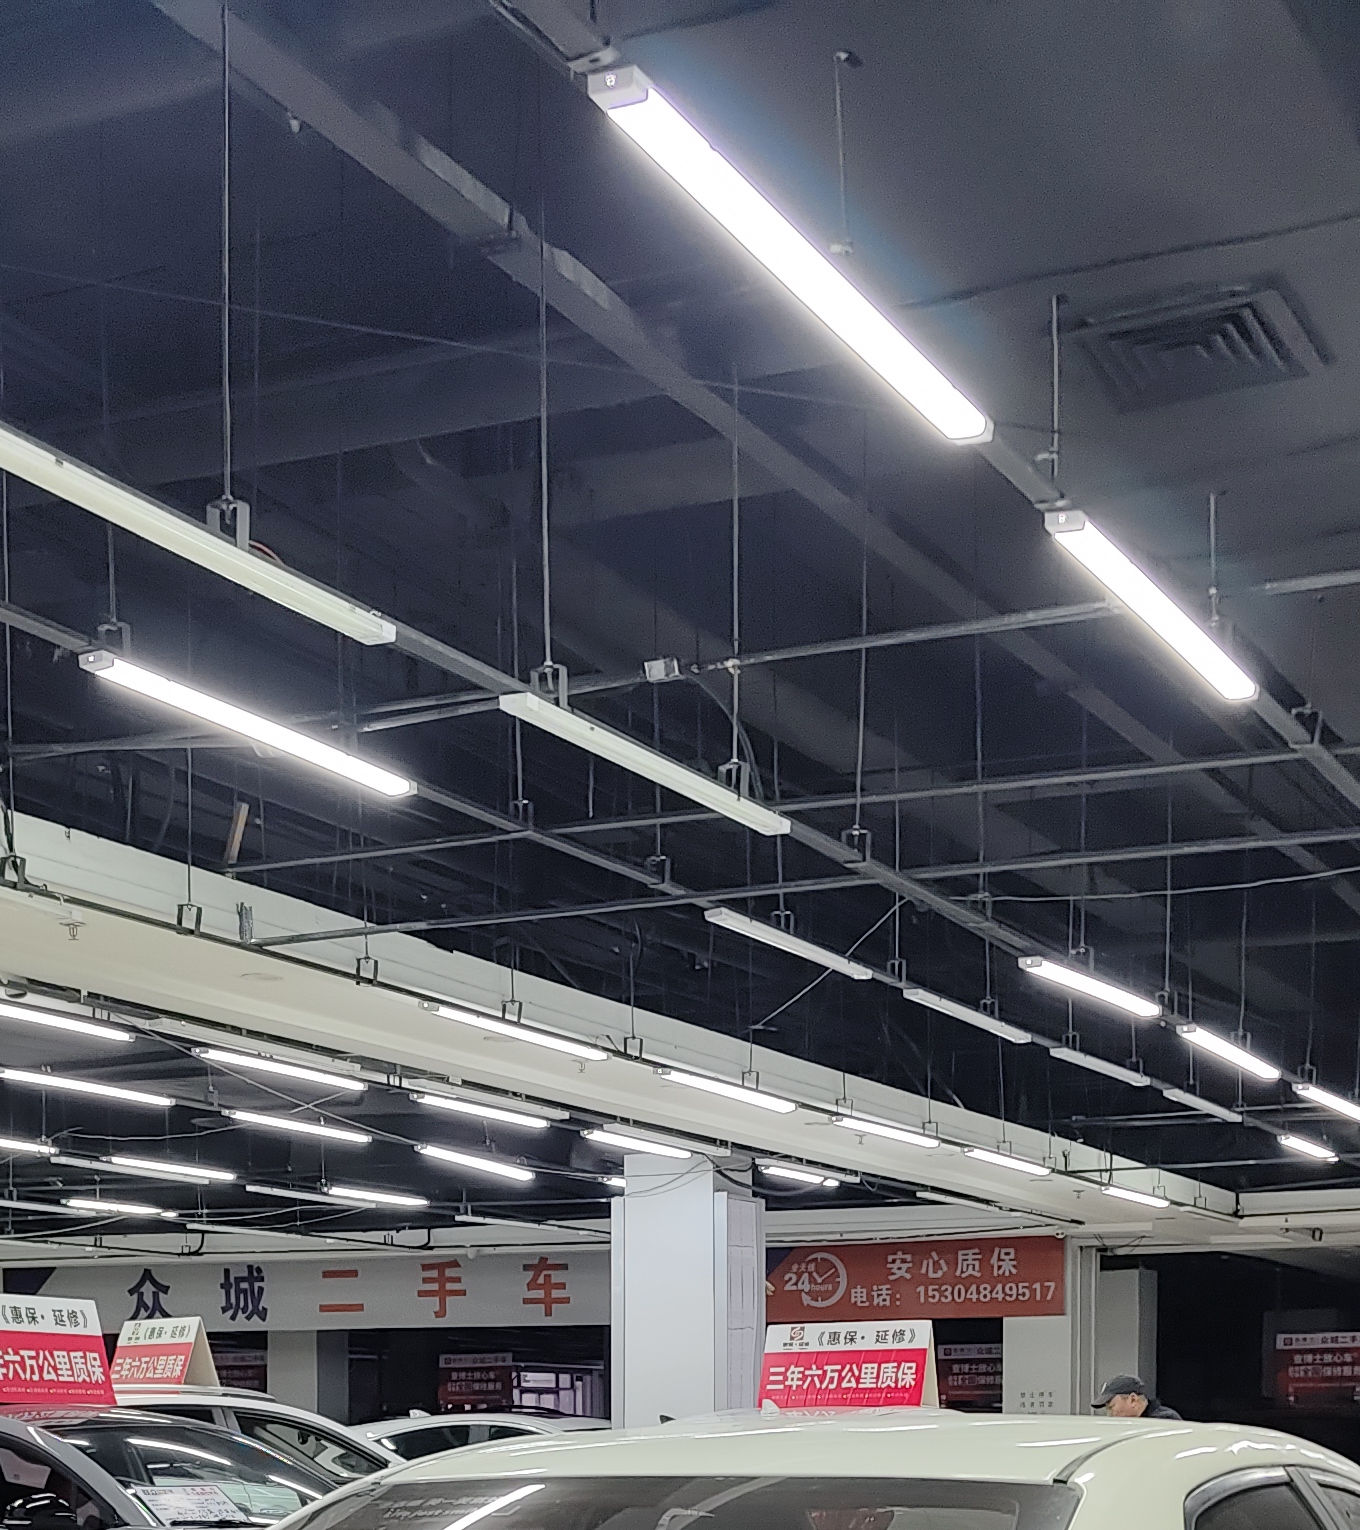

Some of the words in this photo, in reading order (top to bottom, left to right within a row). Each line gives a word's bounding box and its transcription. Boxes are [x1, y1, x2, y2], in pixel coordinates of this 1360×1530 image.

[886, 1247, 1018, 1281] 安心质保
[127, 1256, 571, 1323] 众城二手车
[783, 1273, 811, 1292] 24
[111, 1355, 186, 1379] 三年六万公里质保
[766, 1361, 917, 1391] 三年六万公里质保
